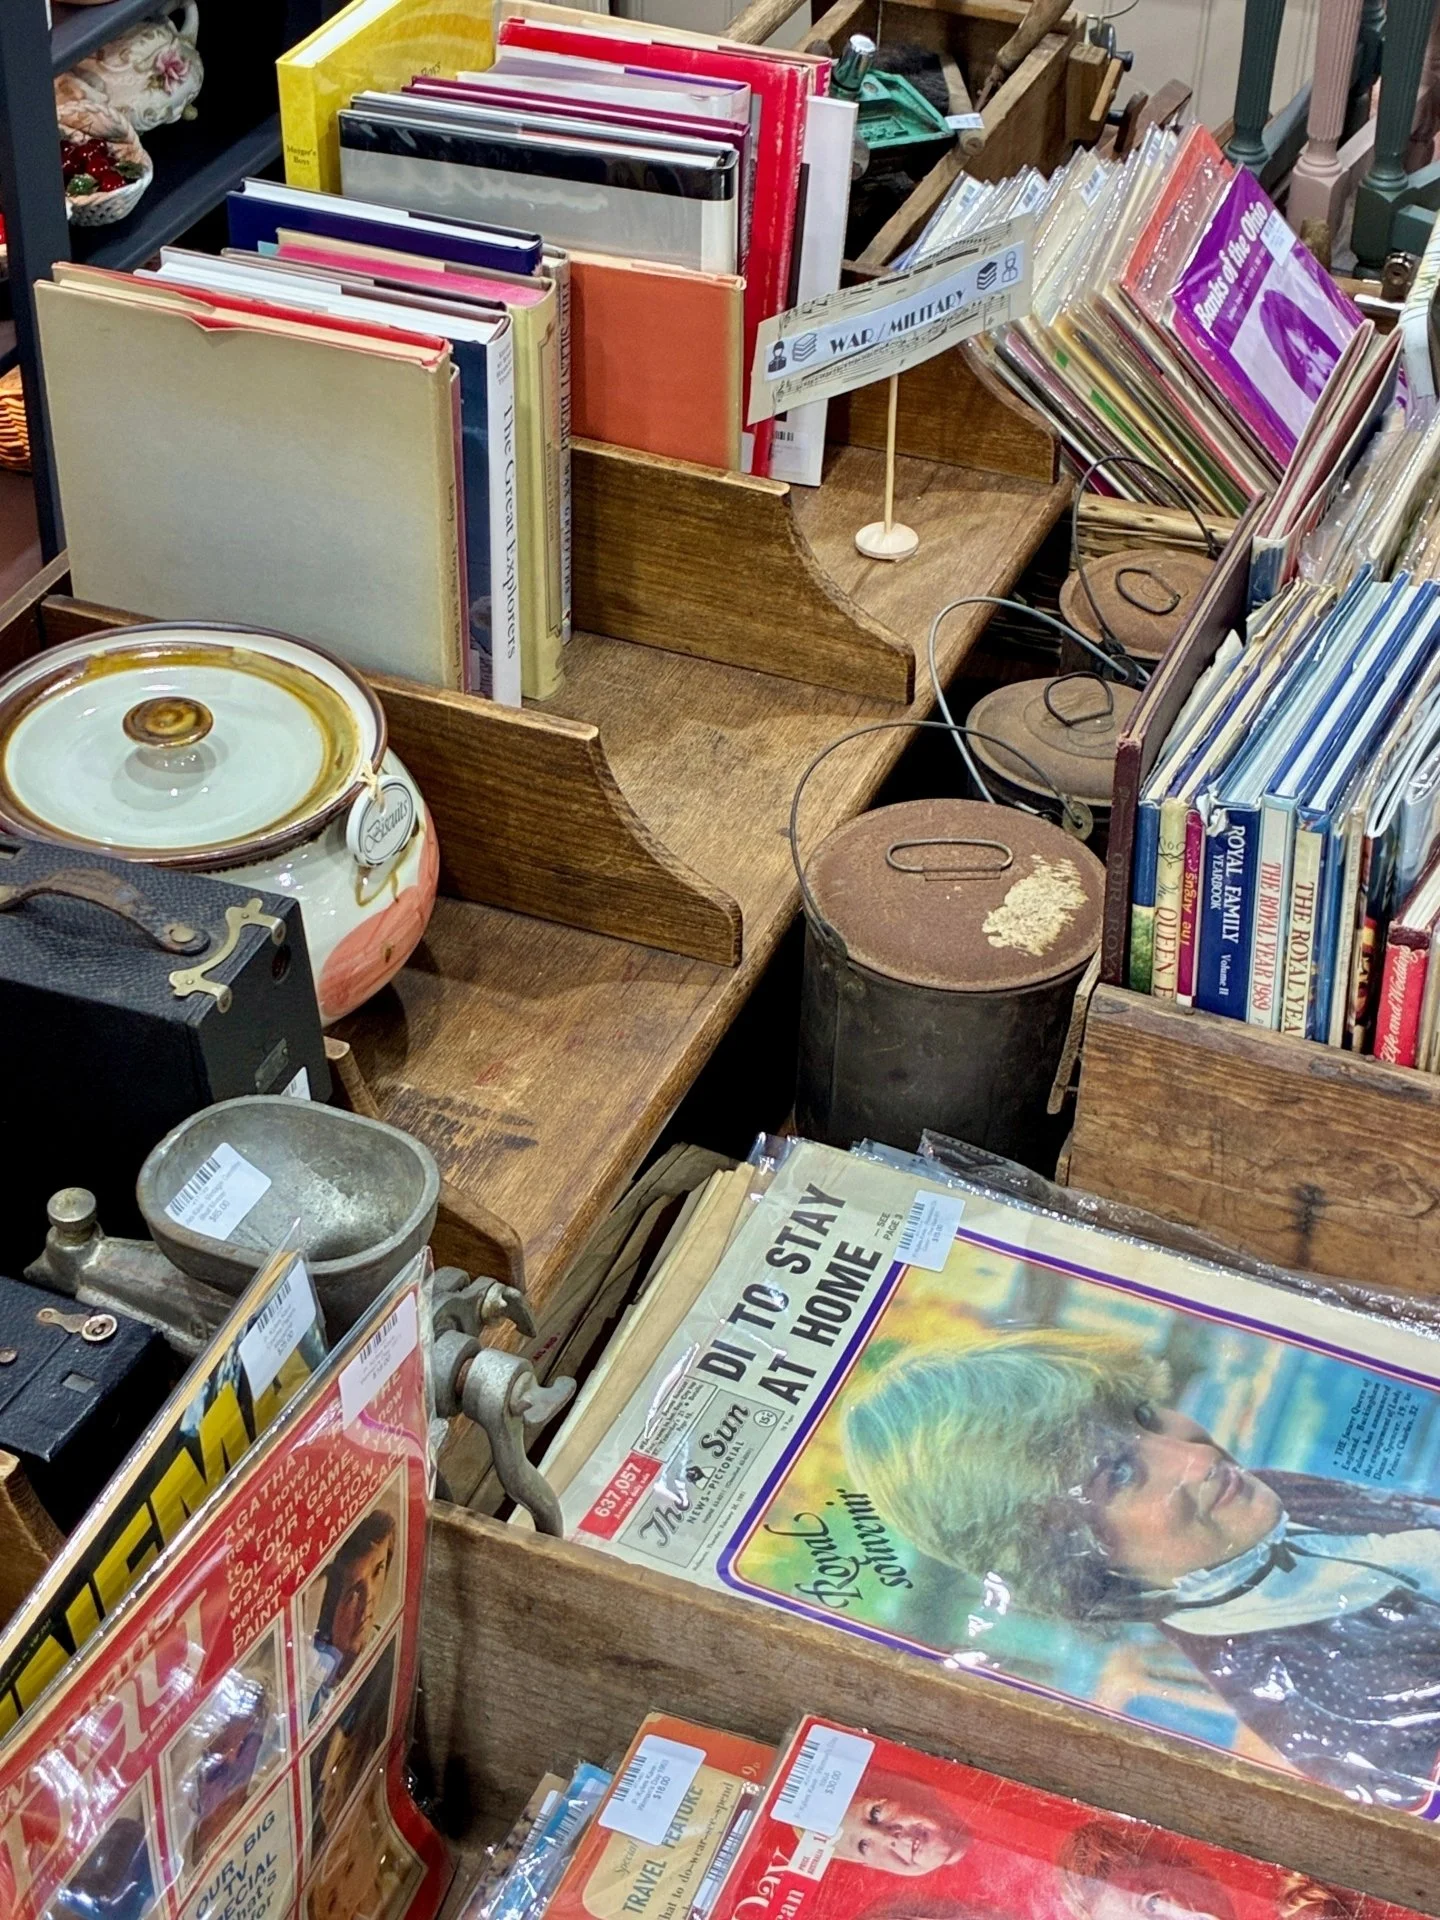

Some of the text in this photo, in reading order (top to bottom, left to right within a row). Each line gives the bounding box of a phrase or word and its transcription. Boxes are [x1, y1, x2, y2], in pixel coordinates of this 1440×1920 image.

[1228, 235, 1251, 269] the
[1240, 201, 1269, 243] Ohio
[1193, 275, 1230, 331] Banks
[1219, 249, 1239, 285] of
[503, 395, 515, 454] The
[504, 458, 516, 537] Great
[502, 538, 518, 661] Explorers
[365, 800, 409, 853] Biscuits
[1103, 852, 1126, 981] OUR ROYA
[1180, 871, 1197, 946] The Argus
[1209, 854, 1225, 911] YEARBOOK
[1222, 825, 1246, 945] ROYAL FAMILY
[1155, 906, 1178, 979] QUEEN
[1219, 953, 1232, 987] Volume
[1252, 861, 1281, 1012] THE ROYAL YEAR 1989
[1284, 882, 1315, 1032] THE ROYAL YEA
[1380, 944, 1420, 1063] Life and Wedding
[877, 1212, 891, 1227] SEE
[883, 1220, 900, 1241] PAGE
[697, 1341, 755, 1381] DI
[728, 1284, 788, 1329] TO
[766, 1185, 844, 1274] STAY
[759, 1243, 880, 1404] AT HOME
[1335, 1378, 1371, 1455] THE future Queen of
[1352, 1385, 1390, 1474] Palace has announced
[1356, 1382, 1380, 1431] Buckingham
[1364, 1390, 1402, 1477] the engagement of Lady
[220, 1453, 295, 1543] AGATHA
[223, 1514, 297, 1601] COLOUR
[378, 1387, 402, 1424] new
[595, 1463, 640, 1517] 637,057
[640, 1492, 692, 1546] The
[701, 1405, 748, 1457] Sun
[687, 1442, 744, 1524] NEWS-PICTORIAL
[1373, 1457, 1388, 1481] Diana
[1386, 1452, 1402, 1477] Prince
[221, 1456, 309, 1565] new novel
[224, 1578, 261, 1619] way
[269, 1543, 291, 1565] to
[307, 1457, 368, 1529] assess
[368, 1405, 403, 1449] your
[232, 1423, 409, 1640] personality HOW TO
[233, 1439, 416, 1658] PAINT A LANDSCAPE
[825, 1488, 913, 1589] souvenir
[226, 1561, 243, 1584] to
[763, 1512, 864, 1609] Royal
[650, 1774, 662, 1786] Day
[653, 1776, 670, 1800] $18.00
[825, 1771, 841, 1794] $30.00
[196, 1860, 234, 1919] OUR
[244, 1810, 275, 1856] BIG
[224, 1860, 247, 1896] TV
[615, 1840, 639, 1877] Special
[622, 1786, 704, 1914] TRAVEL FEATURE
[237, 1869, 277, 1920] hat's
[672, 1887, 685, 1899] to
